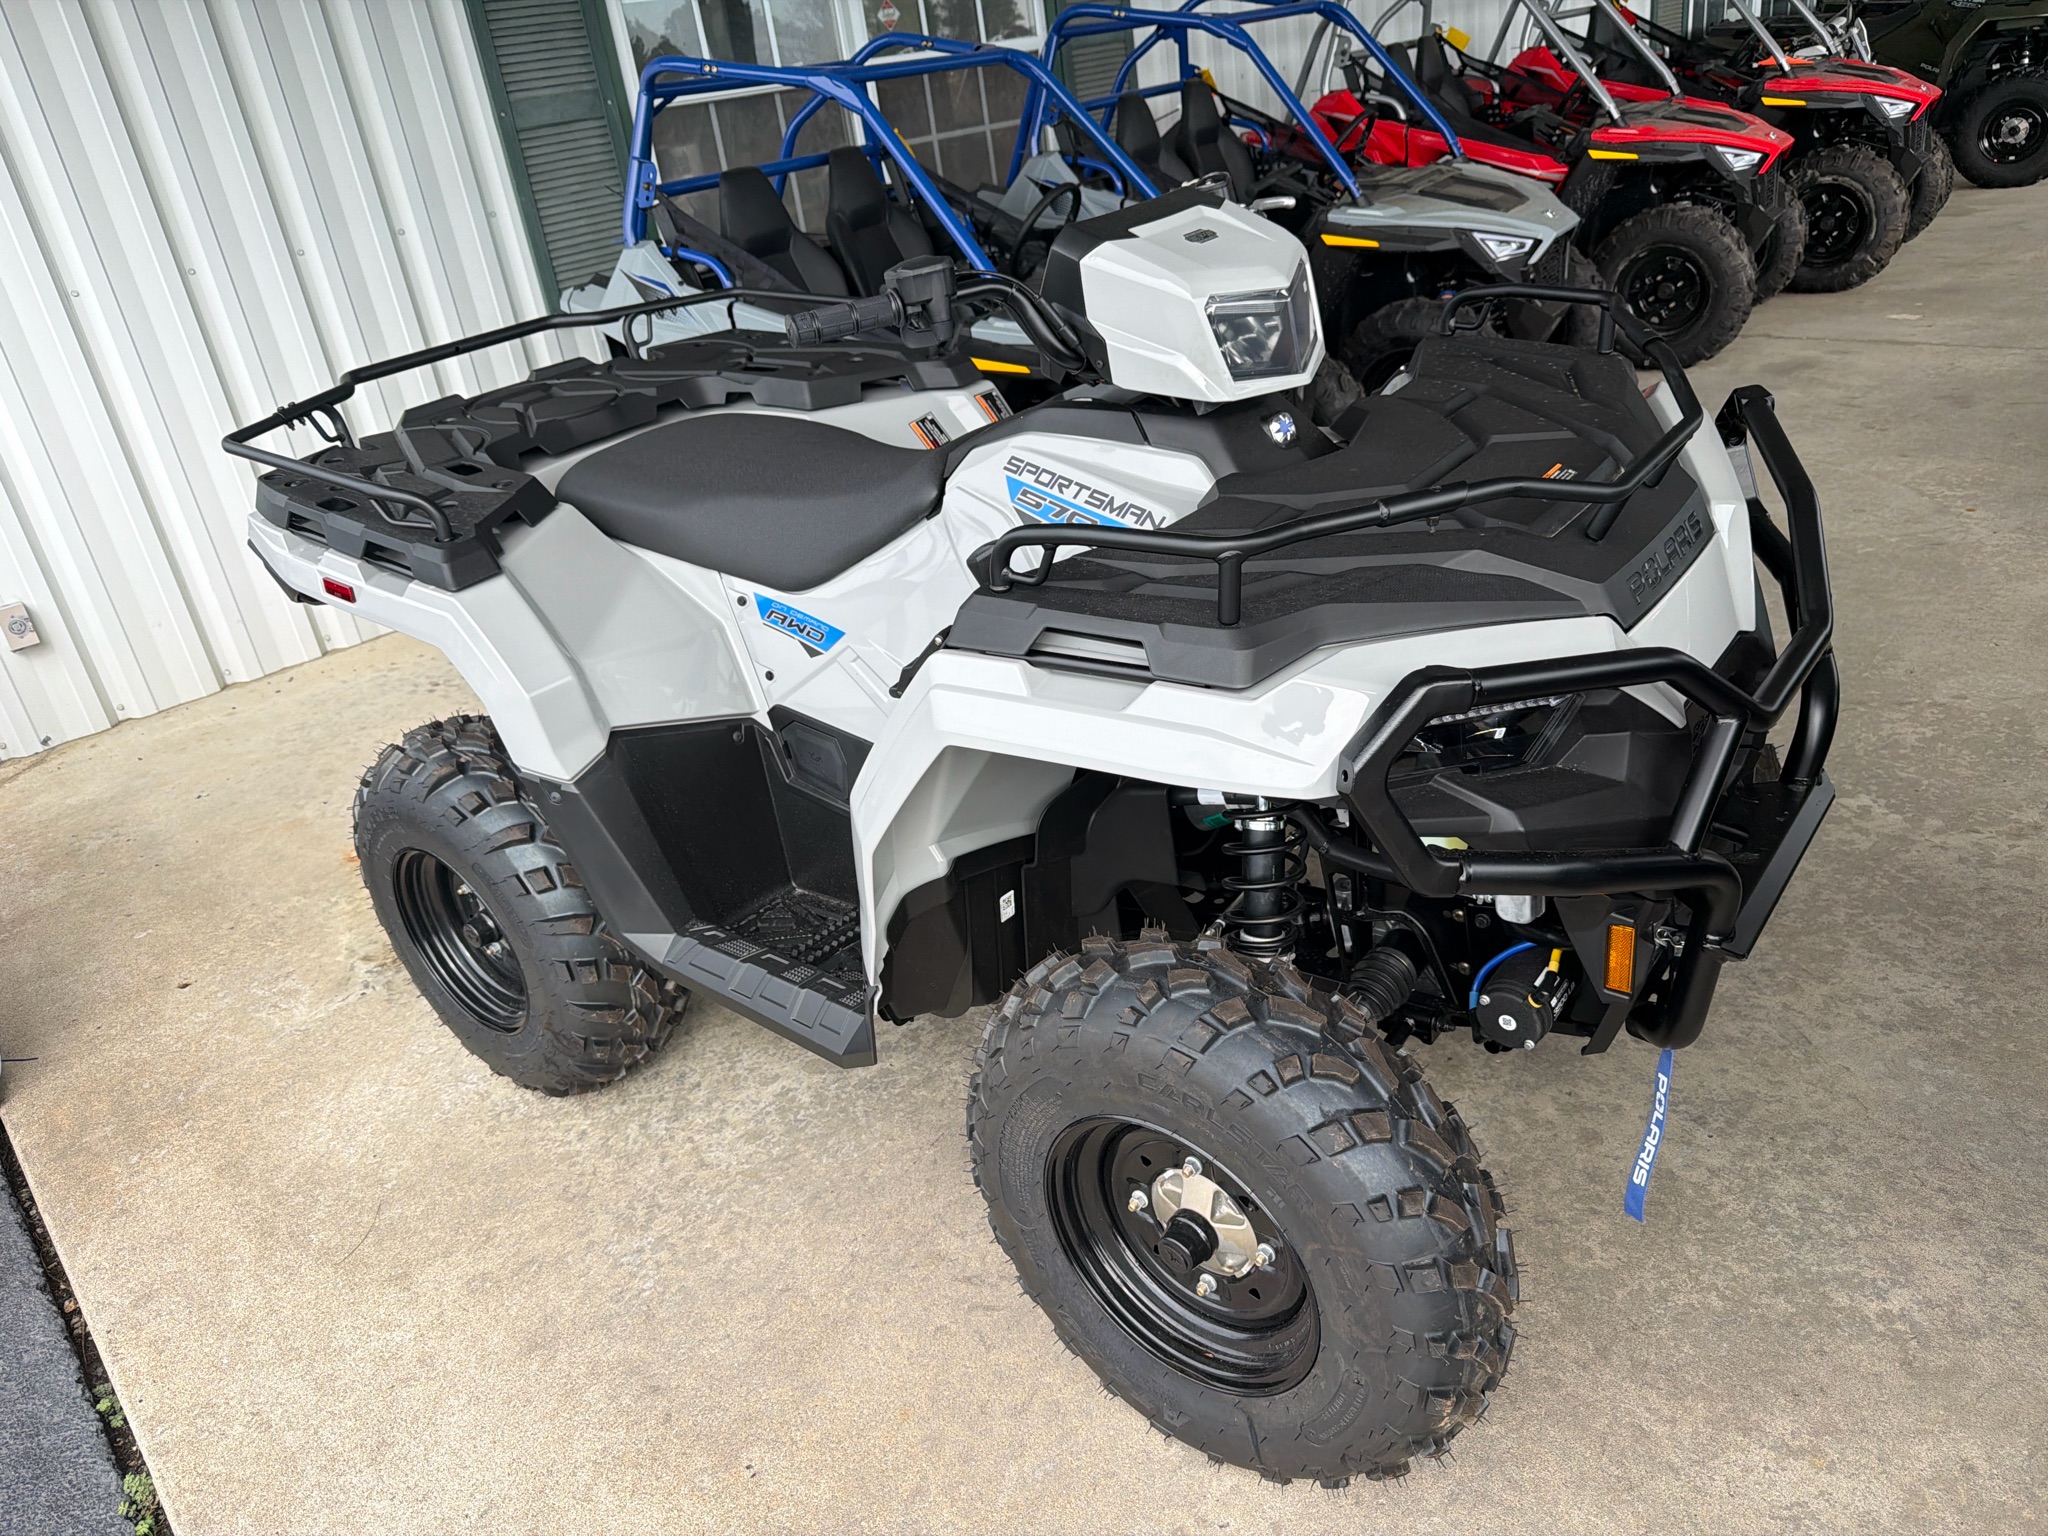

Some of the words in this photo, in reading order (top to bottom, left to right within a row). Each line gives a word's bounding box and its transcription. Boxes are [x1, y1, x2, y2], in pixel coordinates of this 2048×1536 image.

[1002, 455, 1167, 530] SPORTSMAN
[1626, 509, 1704, 607] POLARIS
[765, 609, 826, 642] AWD
[1632, 1072, 1669, 1188] POLARIS
